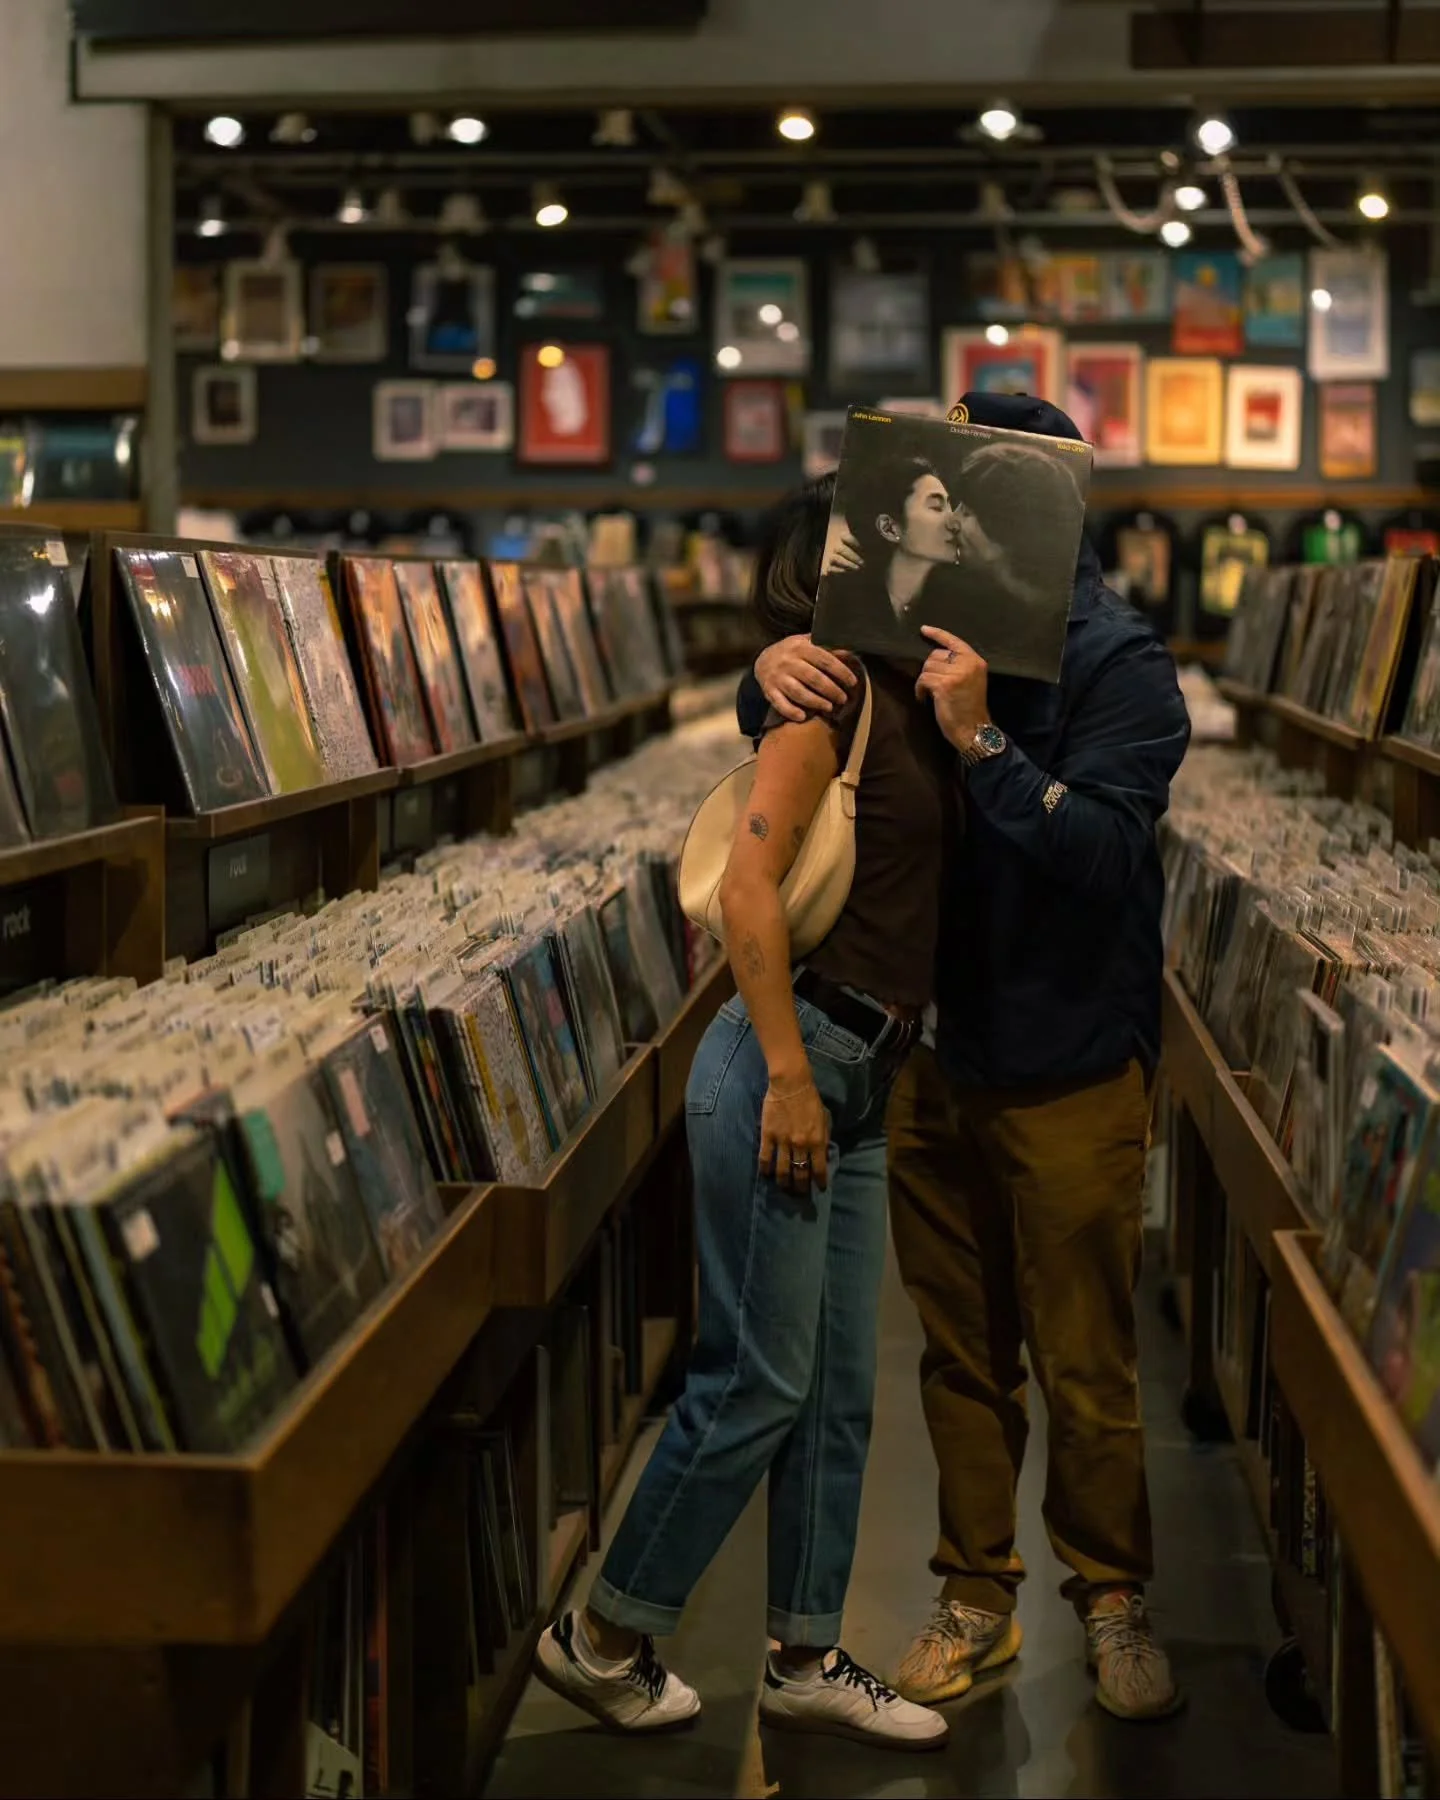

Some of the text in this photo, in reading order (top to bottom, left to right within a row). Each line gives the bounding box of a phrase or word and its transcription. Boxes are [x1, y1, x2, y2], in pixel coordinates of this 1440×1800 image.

[852, 411, 892, 423] John Lennon
[3, 904, 31, 940] rock
